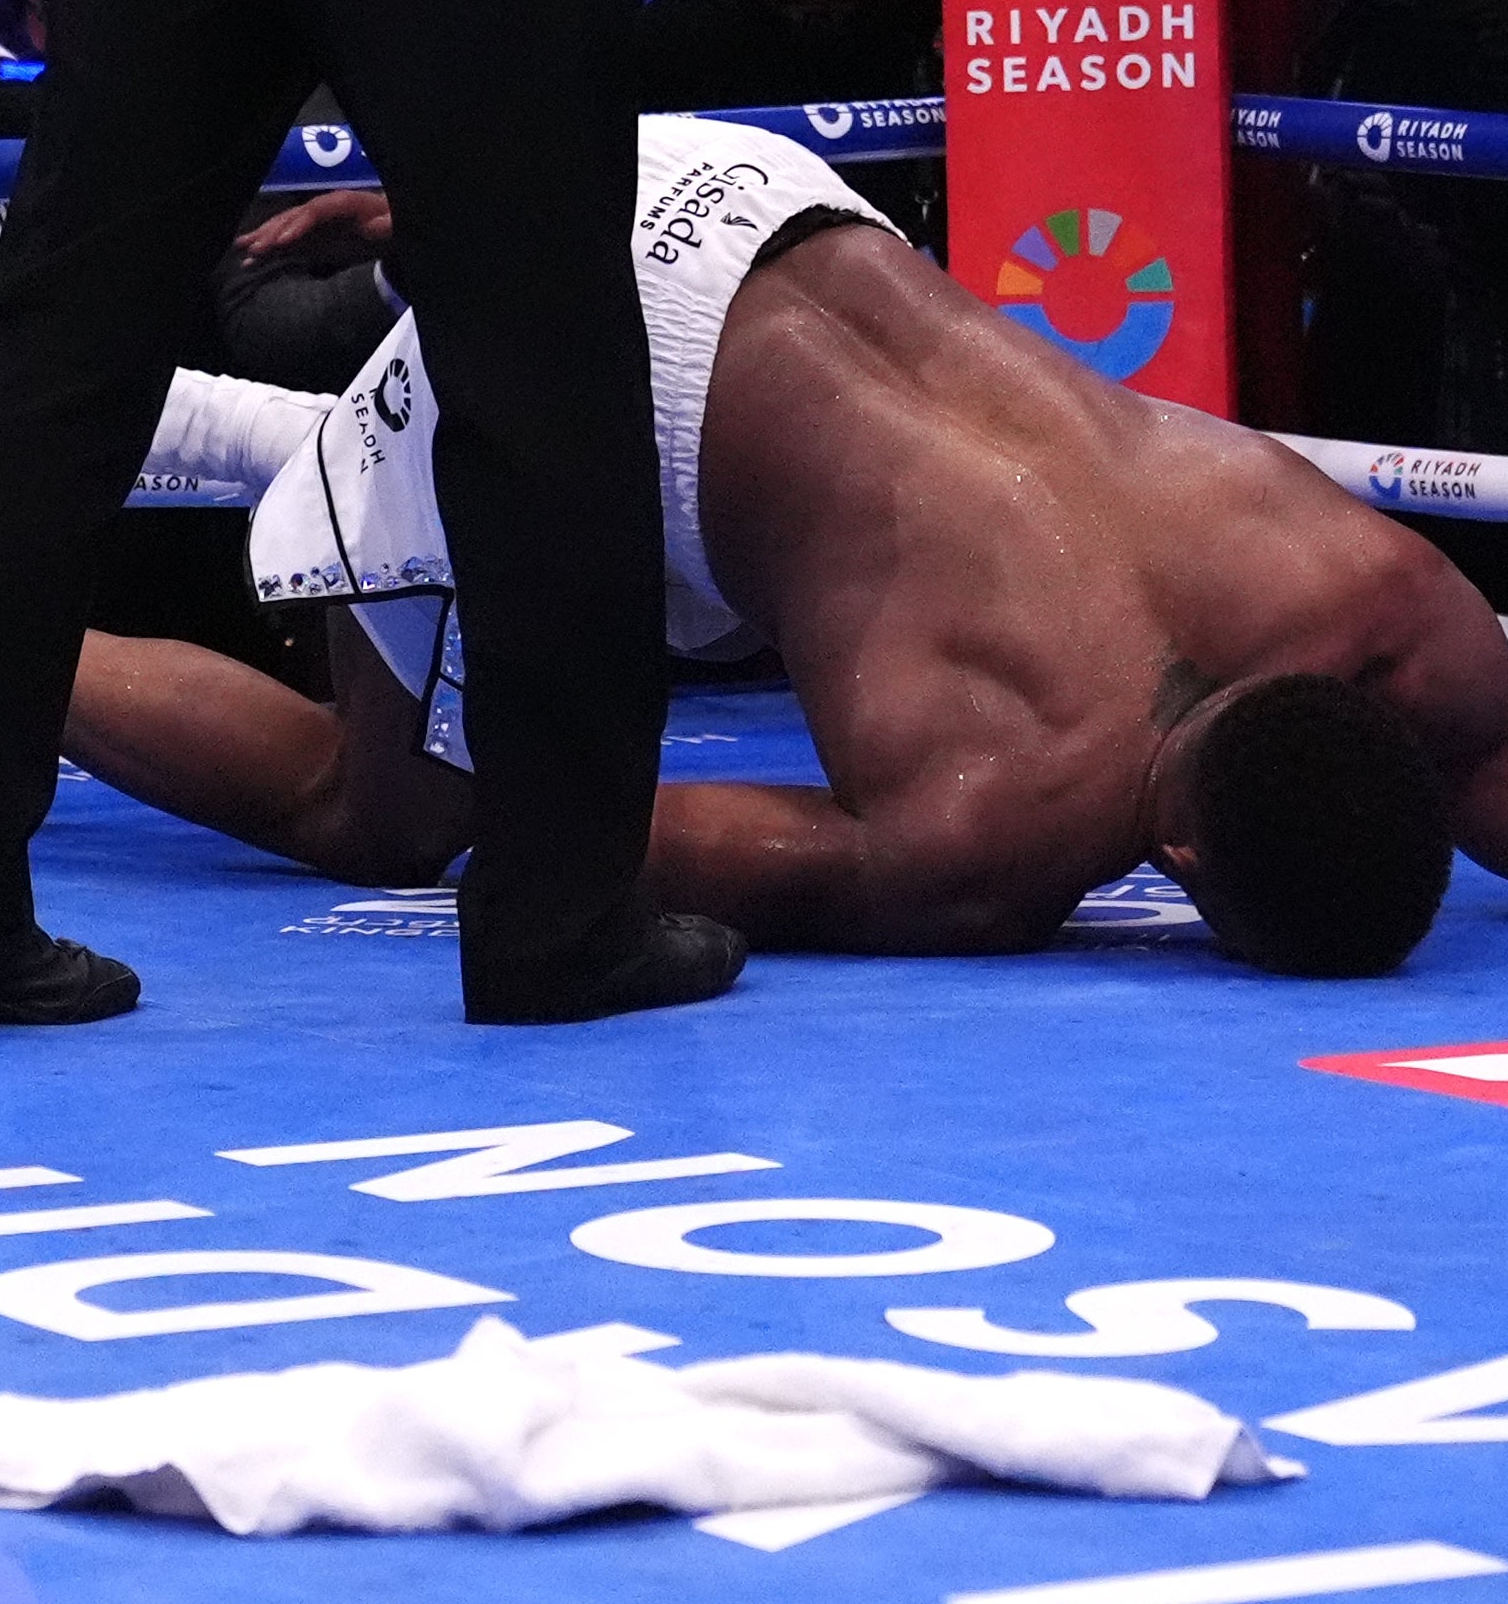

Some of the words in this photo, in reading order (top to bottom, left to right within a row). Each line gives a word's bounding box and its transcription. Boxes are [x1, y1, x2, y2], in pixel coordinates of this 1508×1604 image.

[966, 3, 1194, 46] RIYADH
[966, 51, 1195, 94] SEASON
[1397, 119, 1468, 140] RIYADH
[1396, 140, 1464, 161] SEASON
[640, 162, 714, 230] PARFUMS
[645, 163, 769, 265] Gisada
[1410, 459, 1482, 477] RIYADH
[1408, 479, 1476, 499] SEASON
